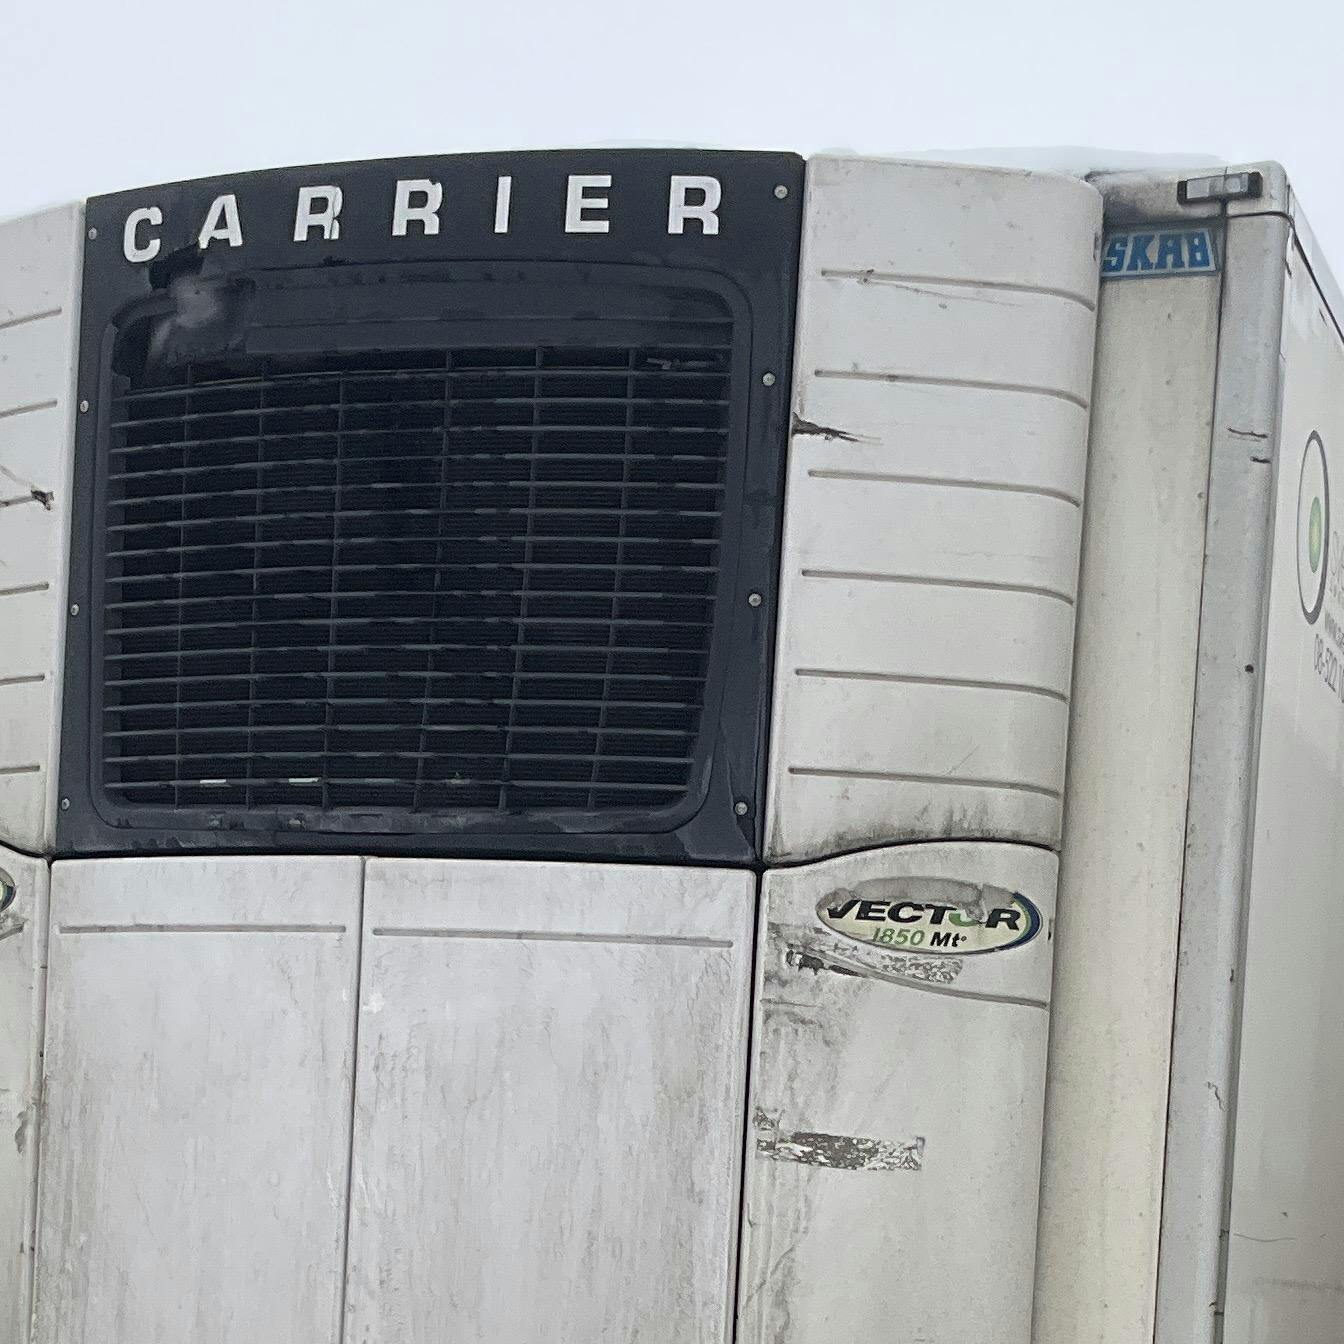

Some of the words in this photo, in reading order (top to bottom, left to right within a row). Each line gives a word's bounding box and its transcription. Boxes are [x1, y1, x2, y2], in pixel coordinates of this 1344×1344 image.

[123, 174, 723, 264] CARRIER
[1102, 231, 1210, 273] SKAB
[827, 899, 1021, 931] VECTOR
[872, 927, 925, 946] 1850
